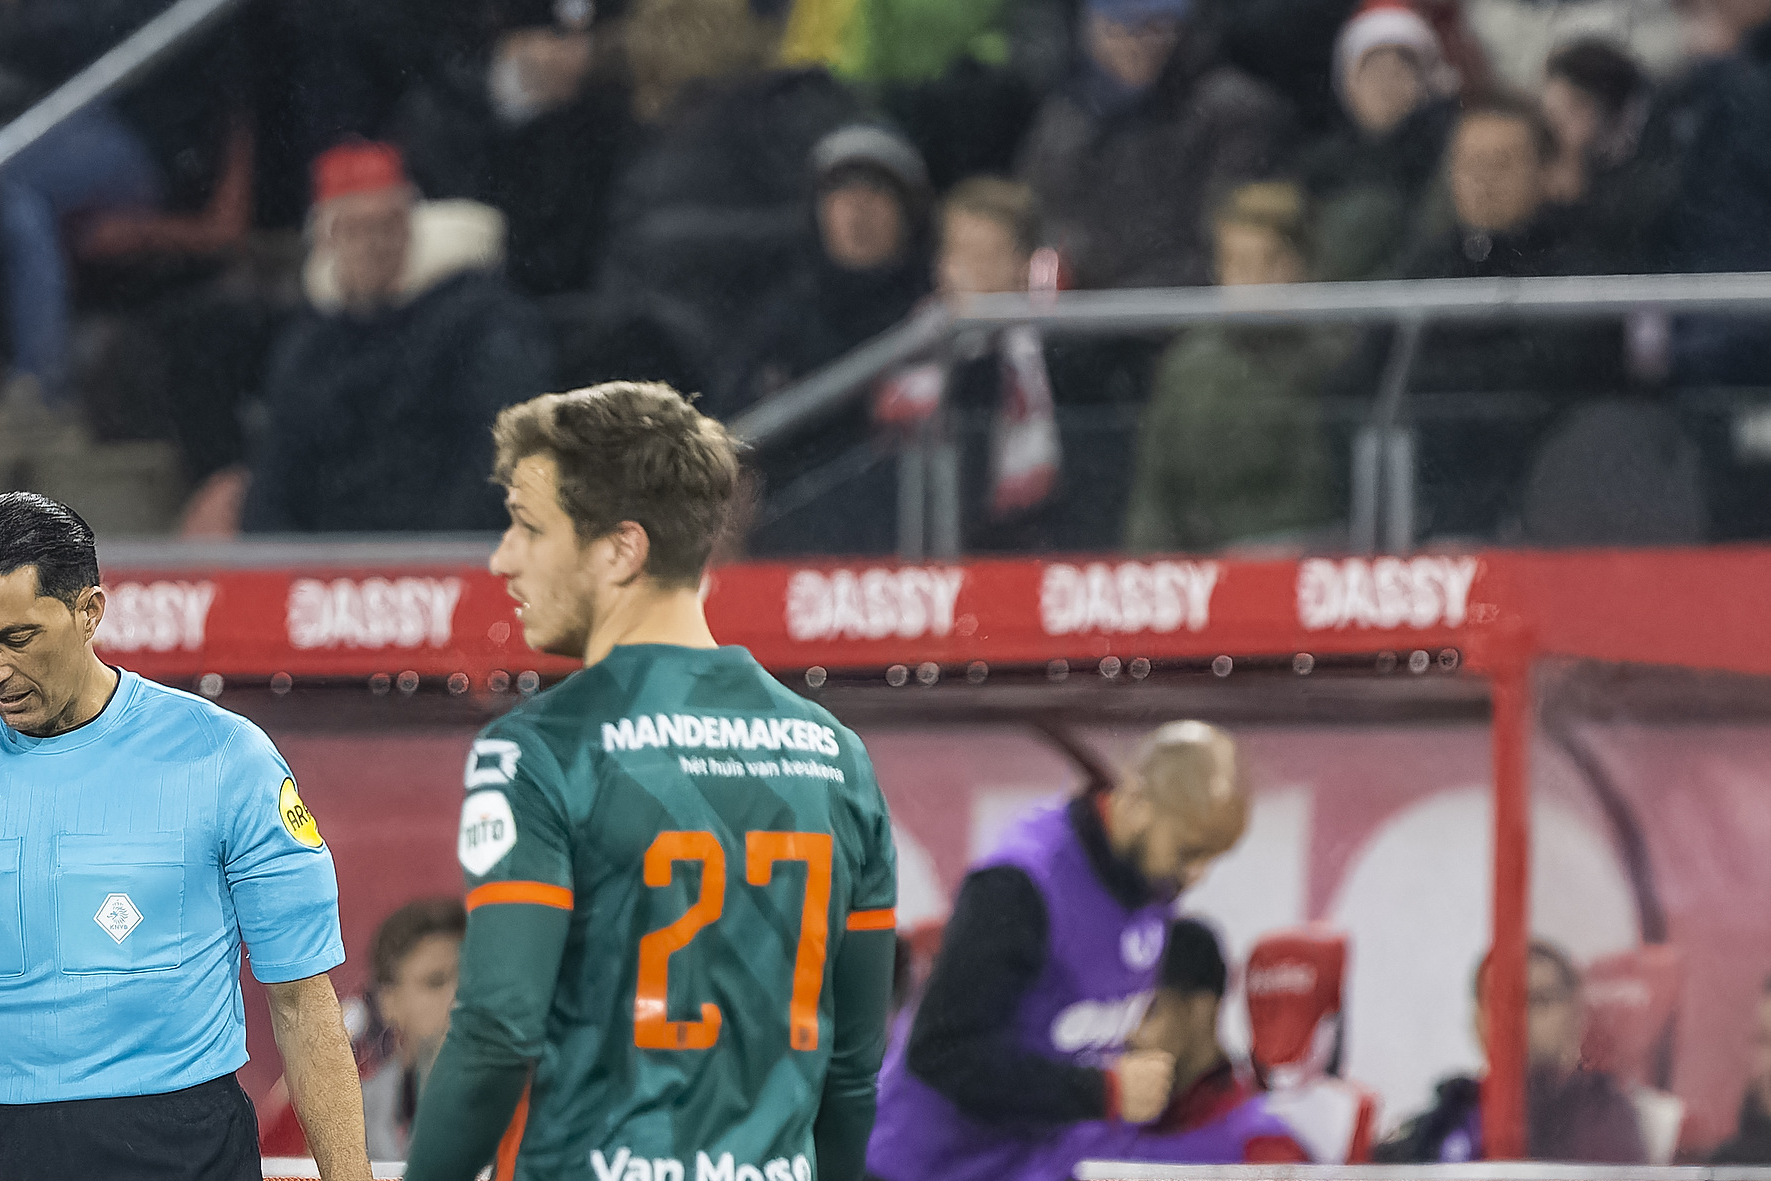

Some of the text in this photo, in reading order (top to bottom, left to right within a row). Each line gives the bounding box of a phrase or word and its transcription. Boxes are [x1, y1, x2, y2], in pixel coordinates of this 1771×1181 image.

[285, 577, 463, 651] DASSY
[785, 567, 966, 640] DASSY
[1039, 561, 1219, 635] DASSY
[1296, 557, 1477, 631] DASSY
[600, 713, 841, 757] MANDEMAKERS
[633, 830, 833, 1051] 27
